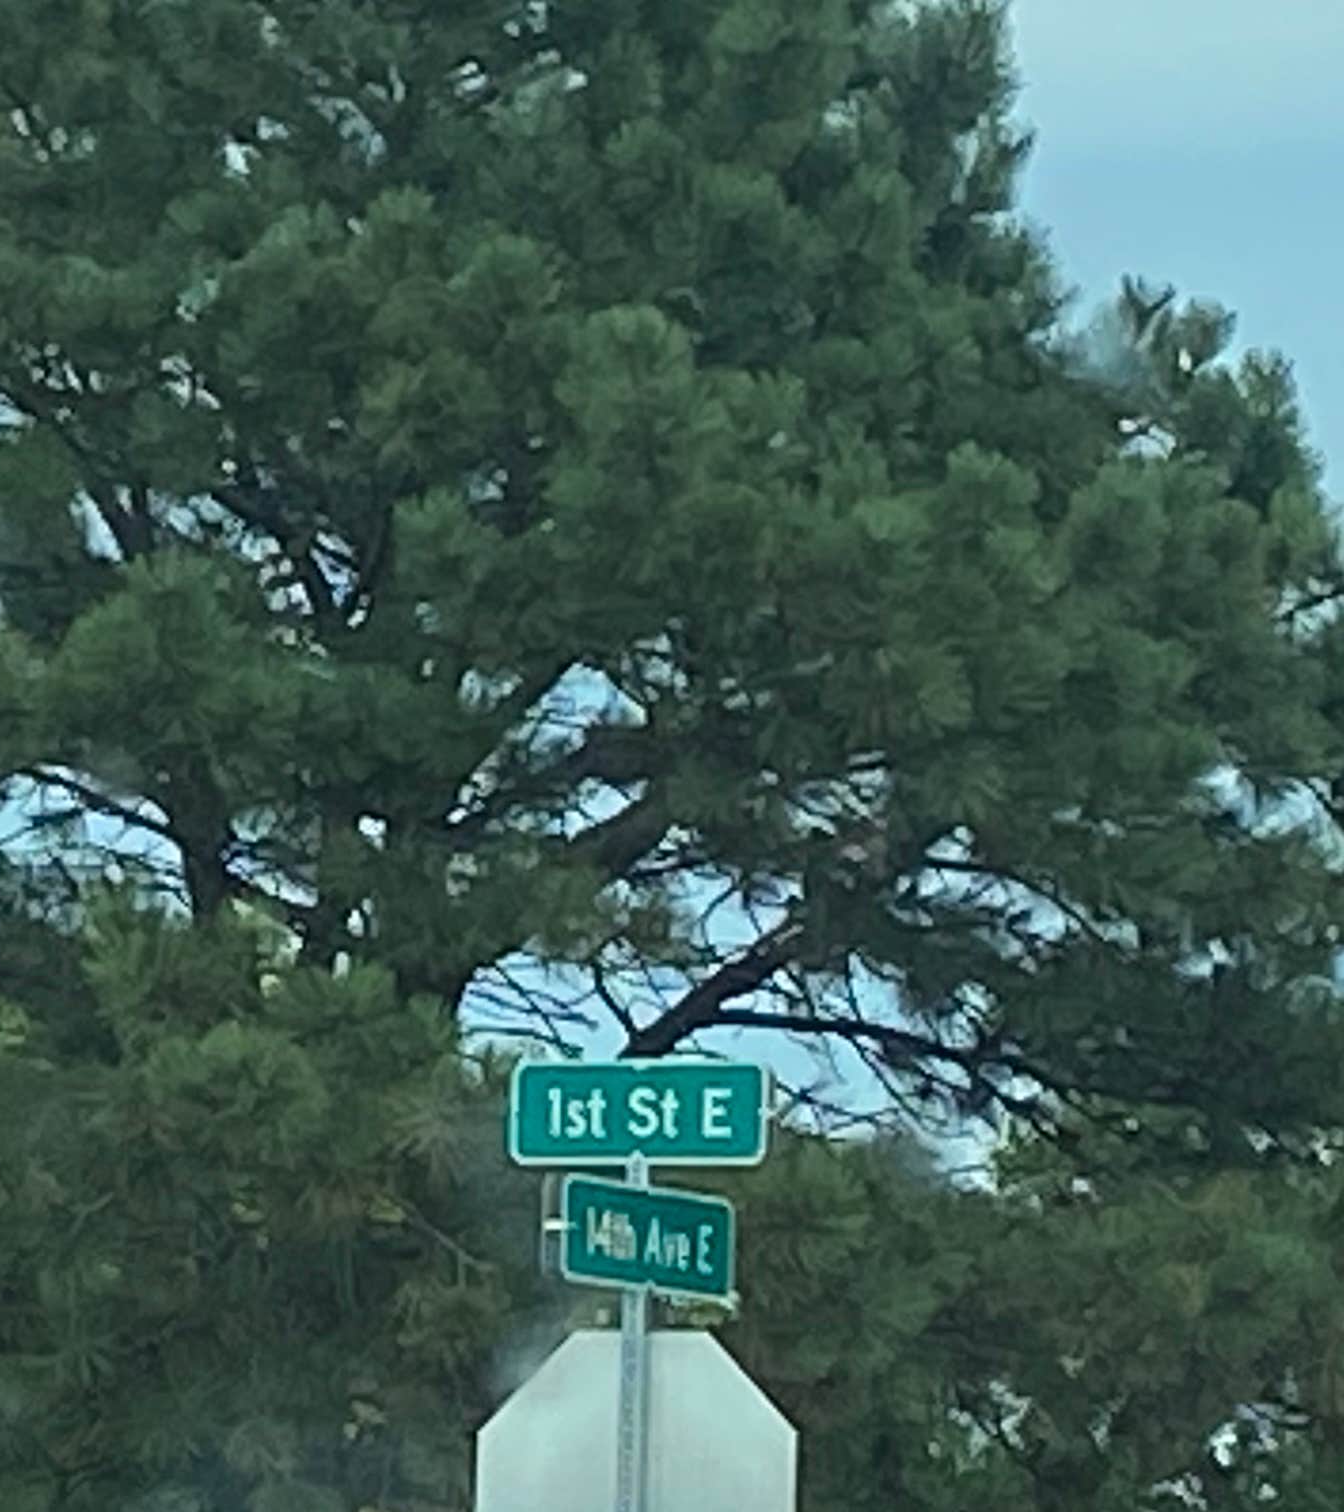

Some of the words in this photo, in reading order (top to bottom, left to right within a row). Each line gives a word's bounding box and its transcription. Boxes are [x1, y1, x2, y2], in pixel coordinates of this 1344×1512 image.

[548, 1087, 606, 1138] 1st
[628, 1087, 679, 1138] St
[703, 1088, 733, 1138] E
[586, 1206, 637, 1260] 14th
[645, 1217, 690, 1271] Ave
[697, 1224, 713, 1275] E
